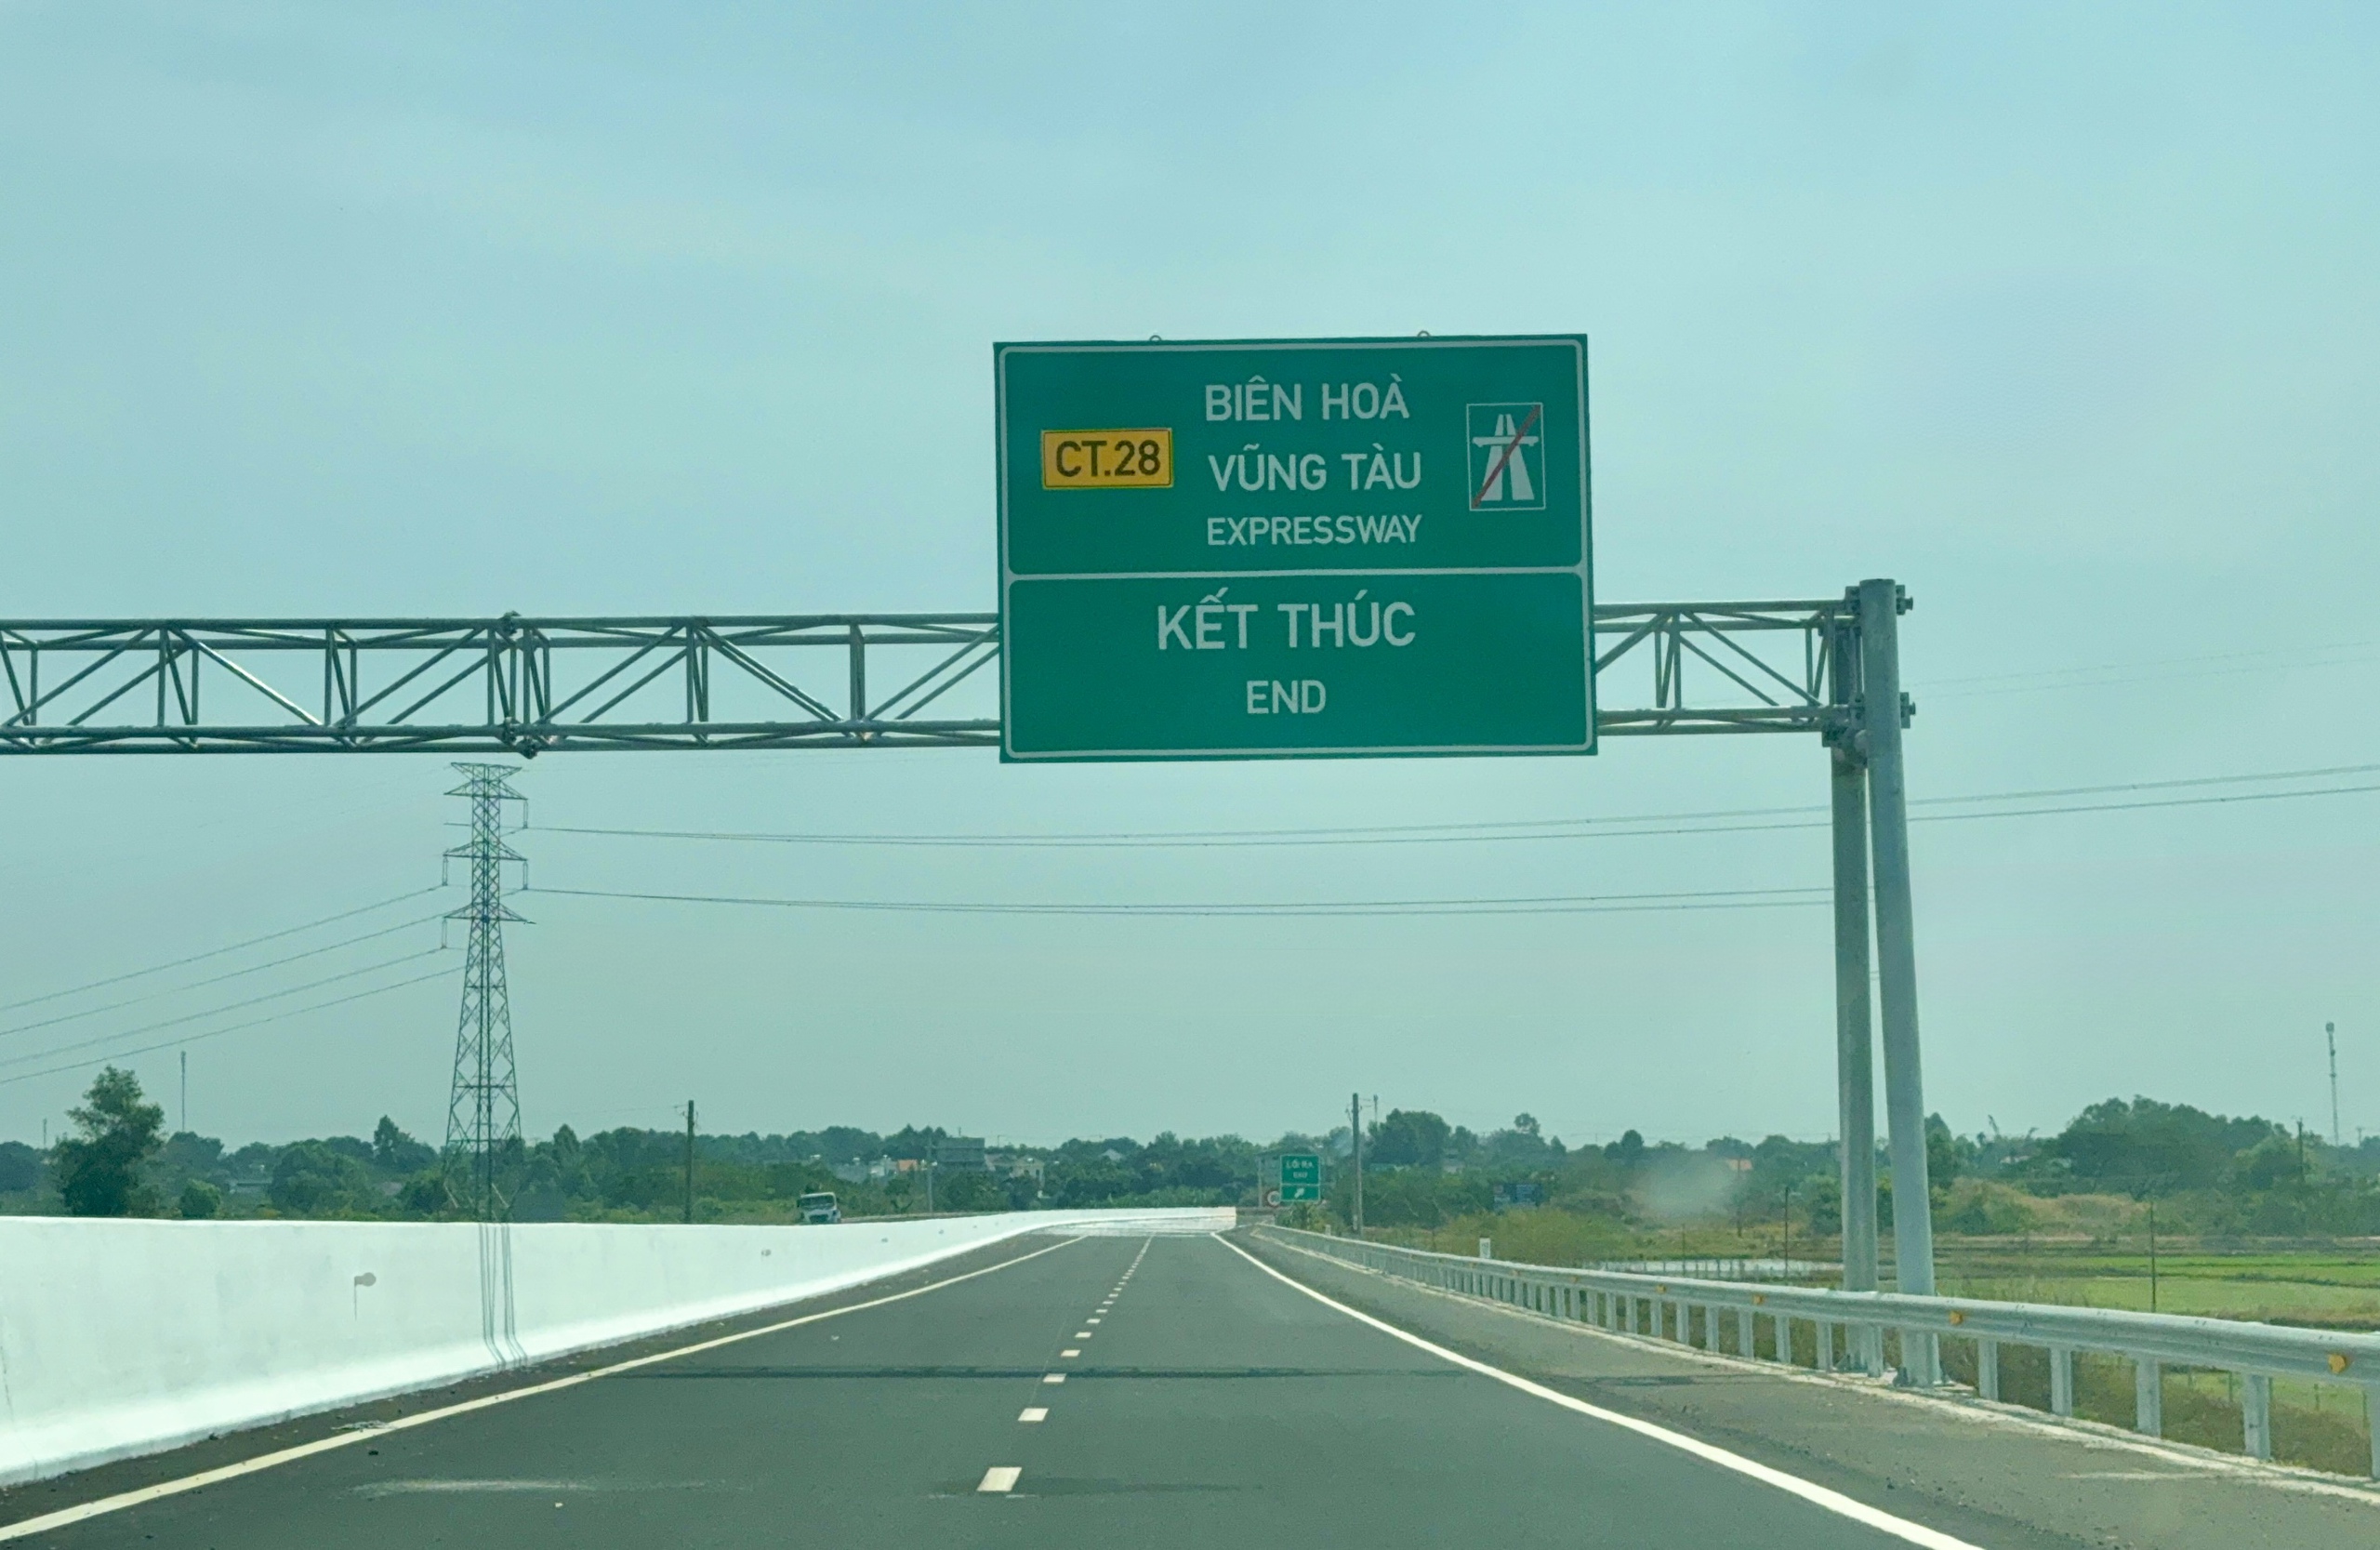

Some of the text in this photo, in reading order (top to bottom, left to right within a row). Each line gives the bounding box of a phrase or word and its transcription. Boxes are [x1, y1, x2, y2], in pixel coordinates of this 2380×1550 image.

[1207, 375, 1409, 420] BIÊN HOÀ
[1055, 440, 1161, 478] CT.28
[1210, 444, 1420, 491] VŨNG TÀU
[1208, 515, 1421, 546] EXPRESSWAY
[1158, 588, 1416, 649] KẾT THÚC
[1248, 681, 1326, 714] END
